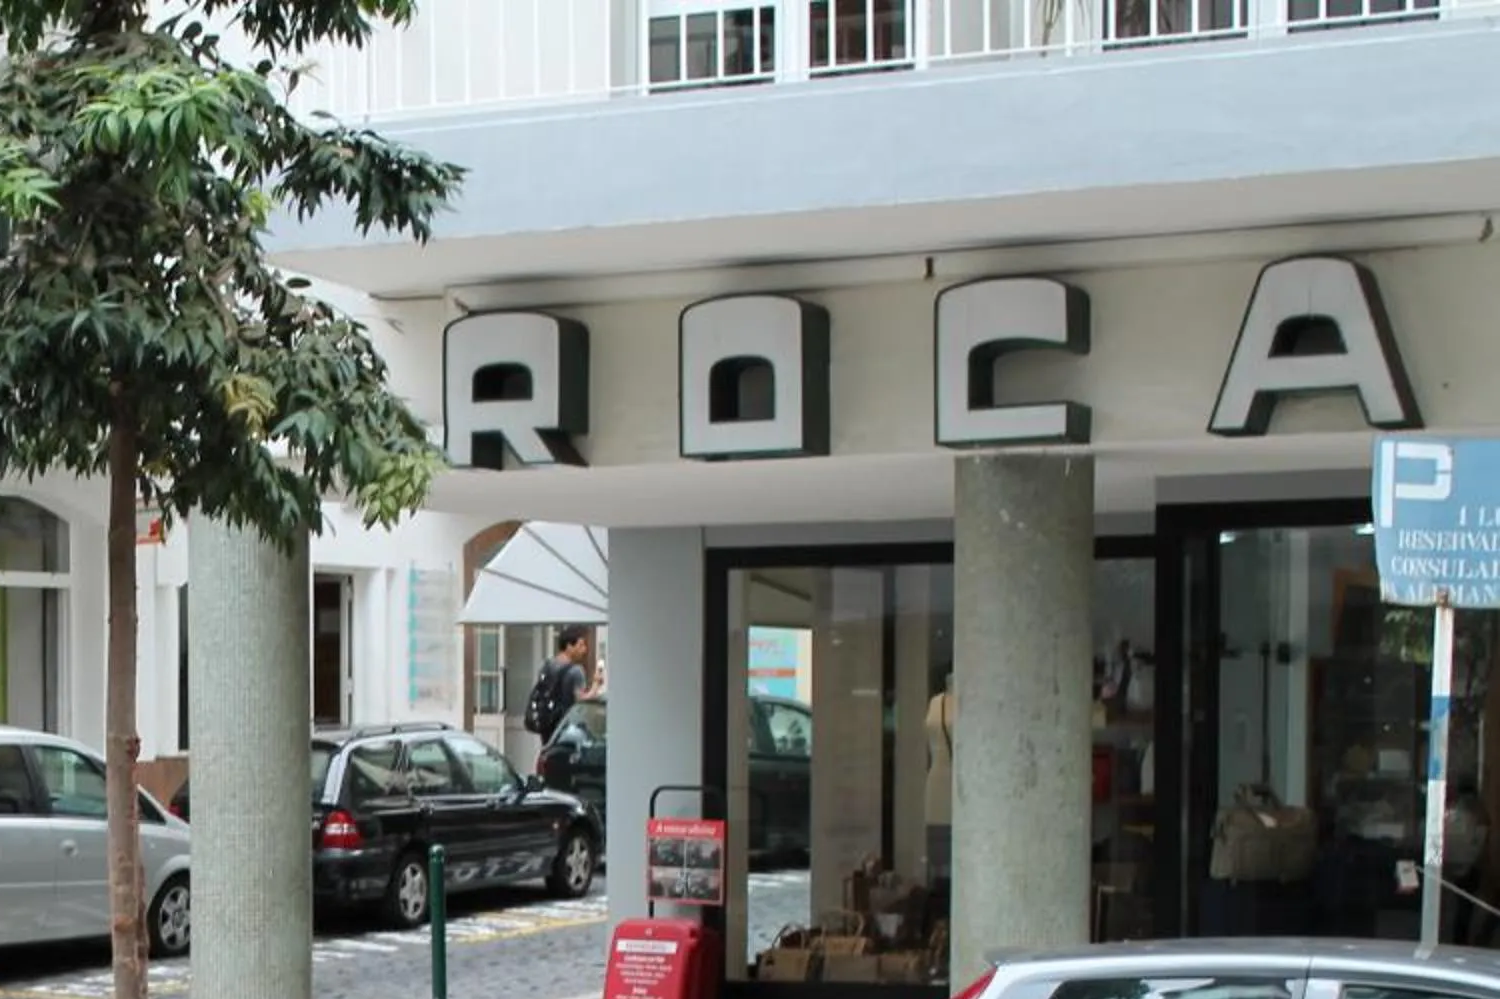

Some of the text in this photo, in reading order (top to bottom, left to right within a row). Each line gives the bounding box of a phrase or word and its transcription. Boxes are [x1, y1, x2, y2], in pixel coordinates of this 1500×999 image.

[443, 254, 1424, 471] ROCA
[1380, 440, 1452, 529] P
[1391, 555, 1500, 580] CONSULA
[1398, 528, 1500, 552] RESERVA
